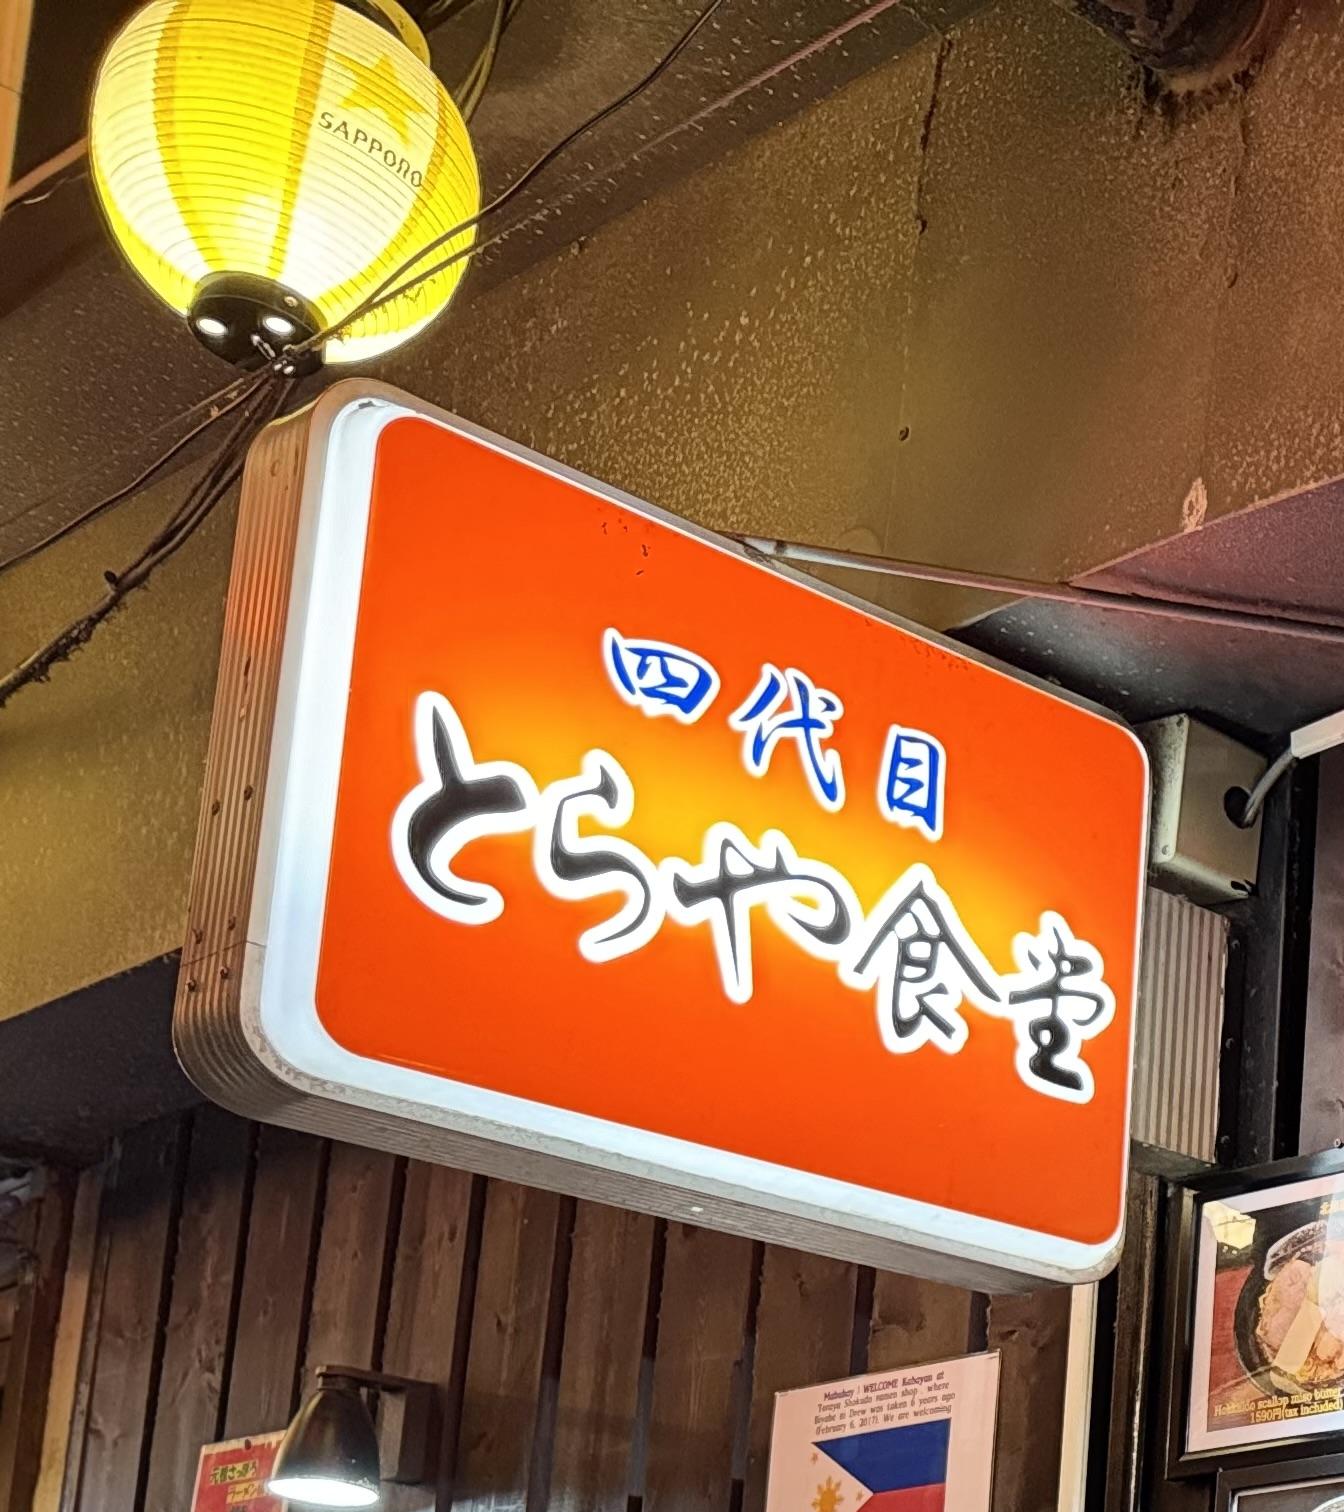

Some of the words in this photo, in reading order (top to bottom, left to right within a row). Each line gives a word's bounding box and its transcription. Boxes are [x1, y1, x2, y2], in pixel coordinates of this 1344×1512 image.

[318, 111, 423, 188] SAPPORO
[605, 628, 946, 836] 四代目
[396, 697, 1113, 1099] とらや食堂
